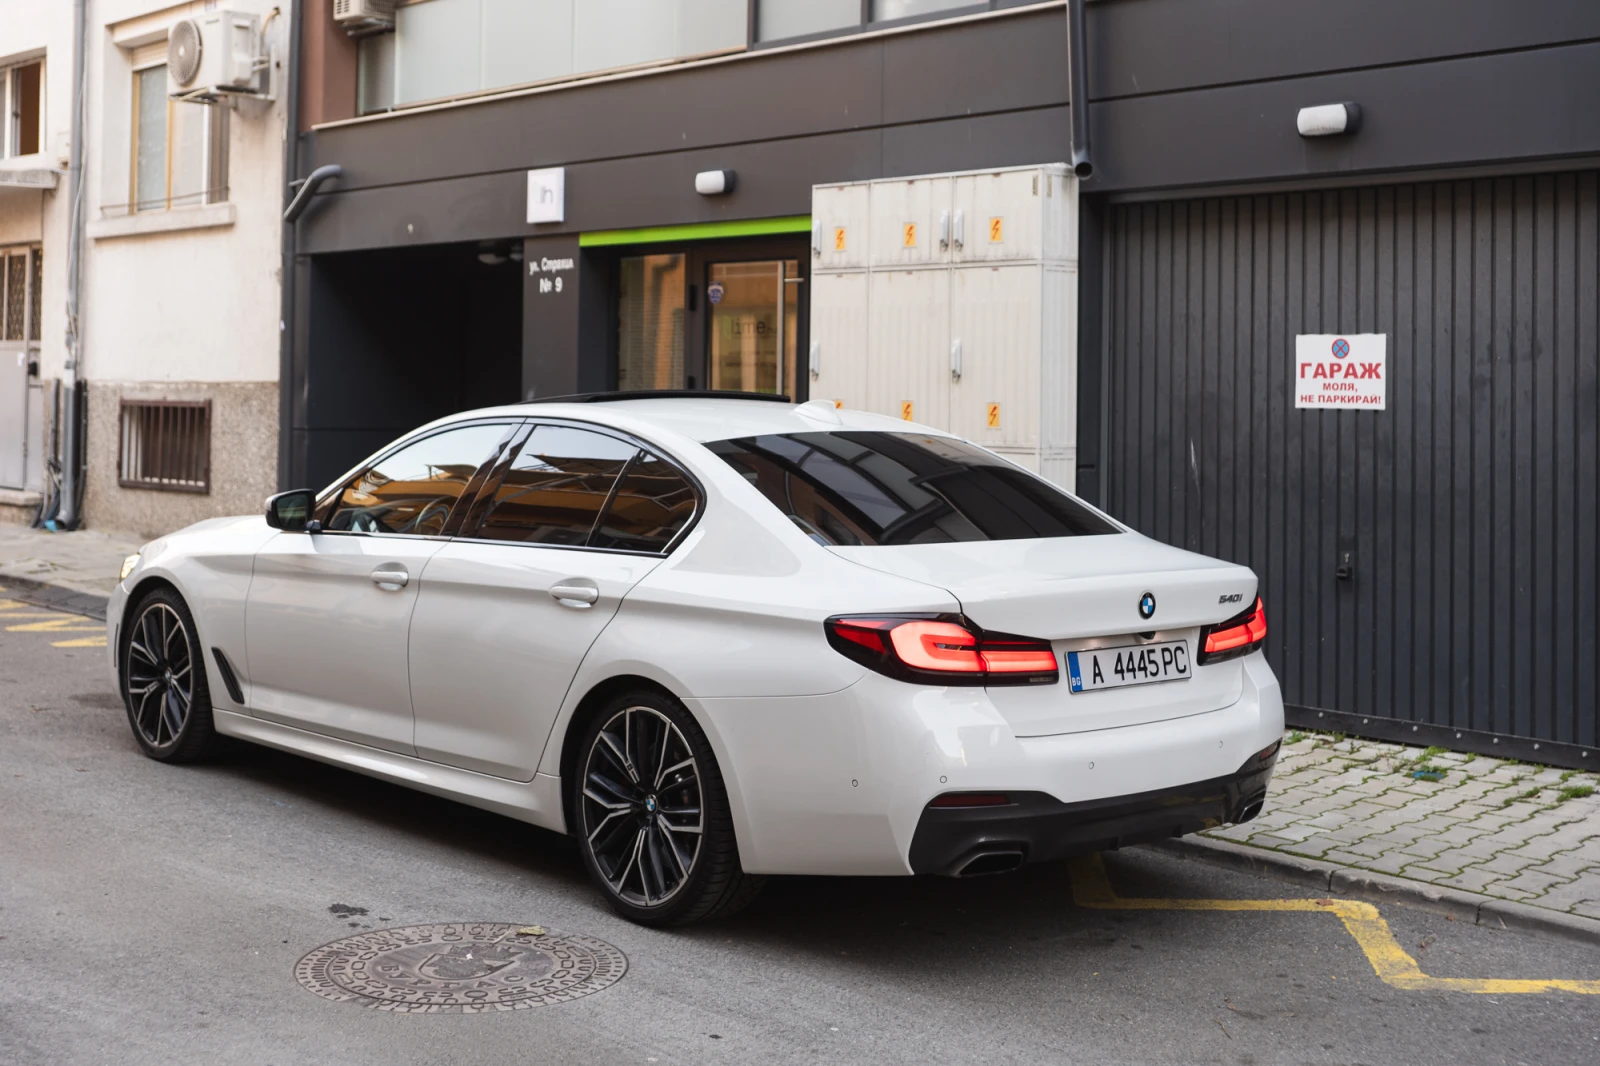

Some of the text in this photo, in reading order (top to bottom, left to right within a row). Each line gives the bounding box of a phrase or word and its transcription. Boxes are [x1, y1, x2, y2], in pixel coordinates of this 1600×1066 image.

[554, 276, 563, 293] 9
[1300, 362, 1382, 379] ГАРАЖ
[1322, 382, 1358, 392] МОЛЯ,
[1300, 394, 1381, 404] НЕ ПАРКИРАЙ!
[1218, 593, 1244, 605] 540i
[1092, 654, 1105, 685] A
[1071, 676, 1082, 687] BG
